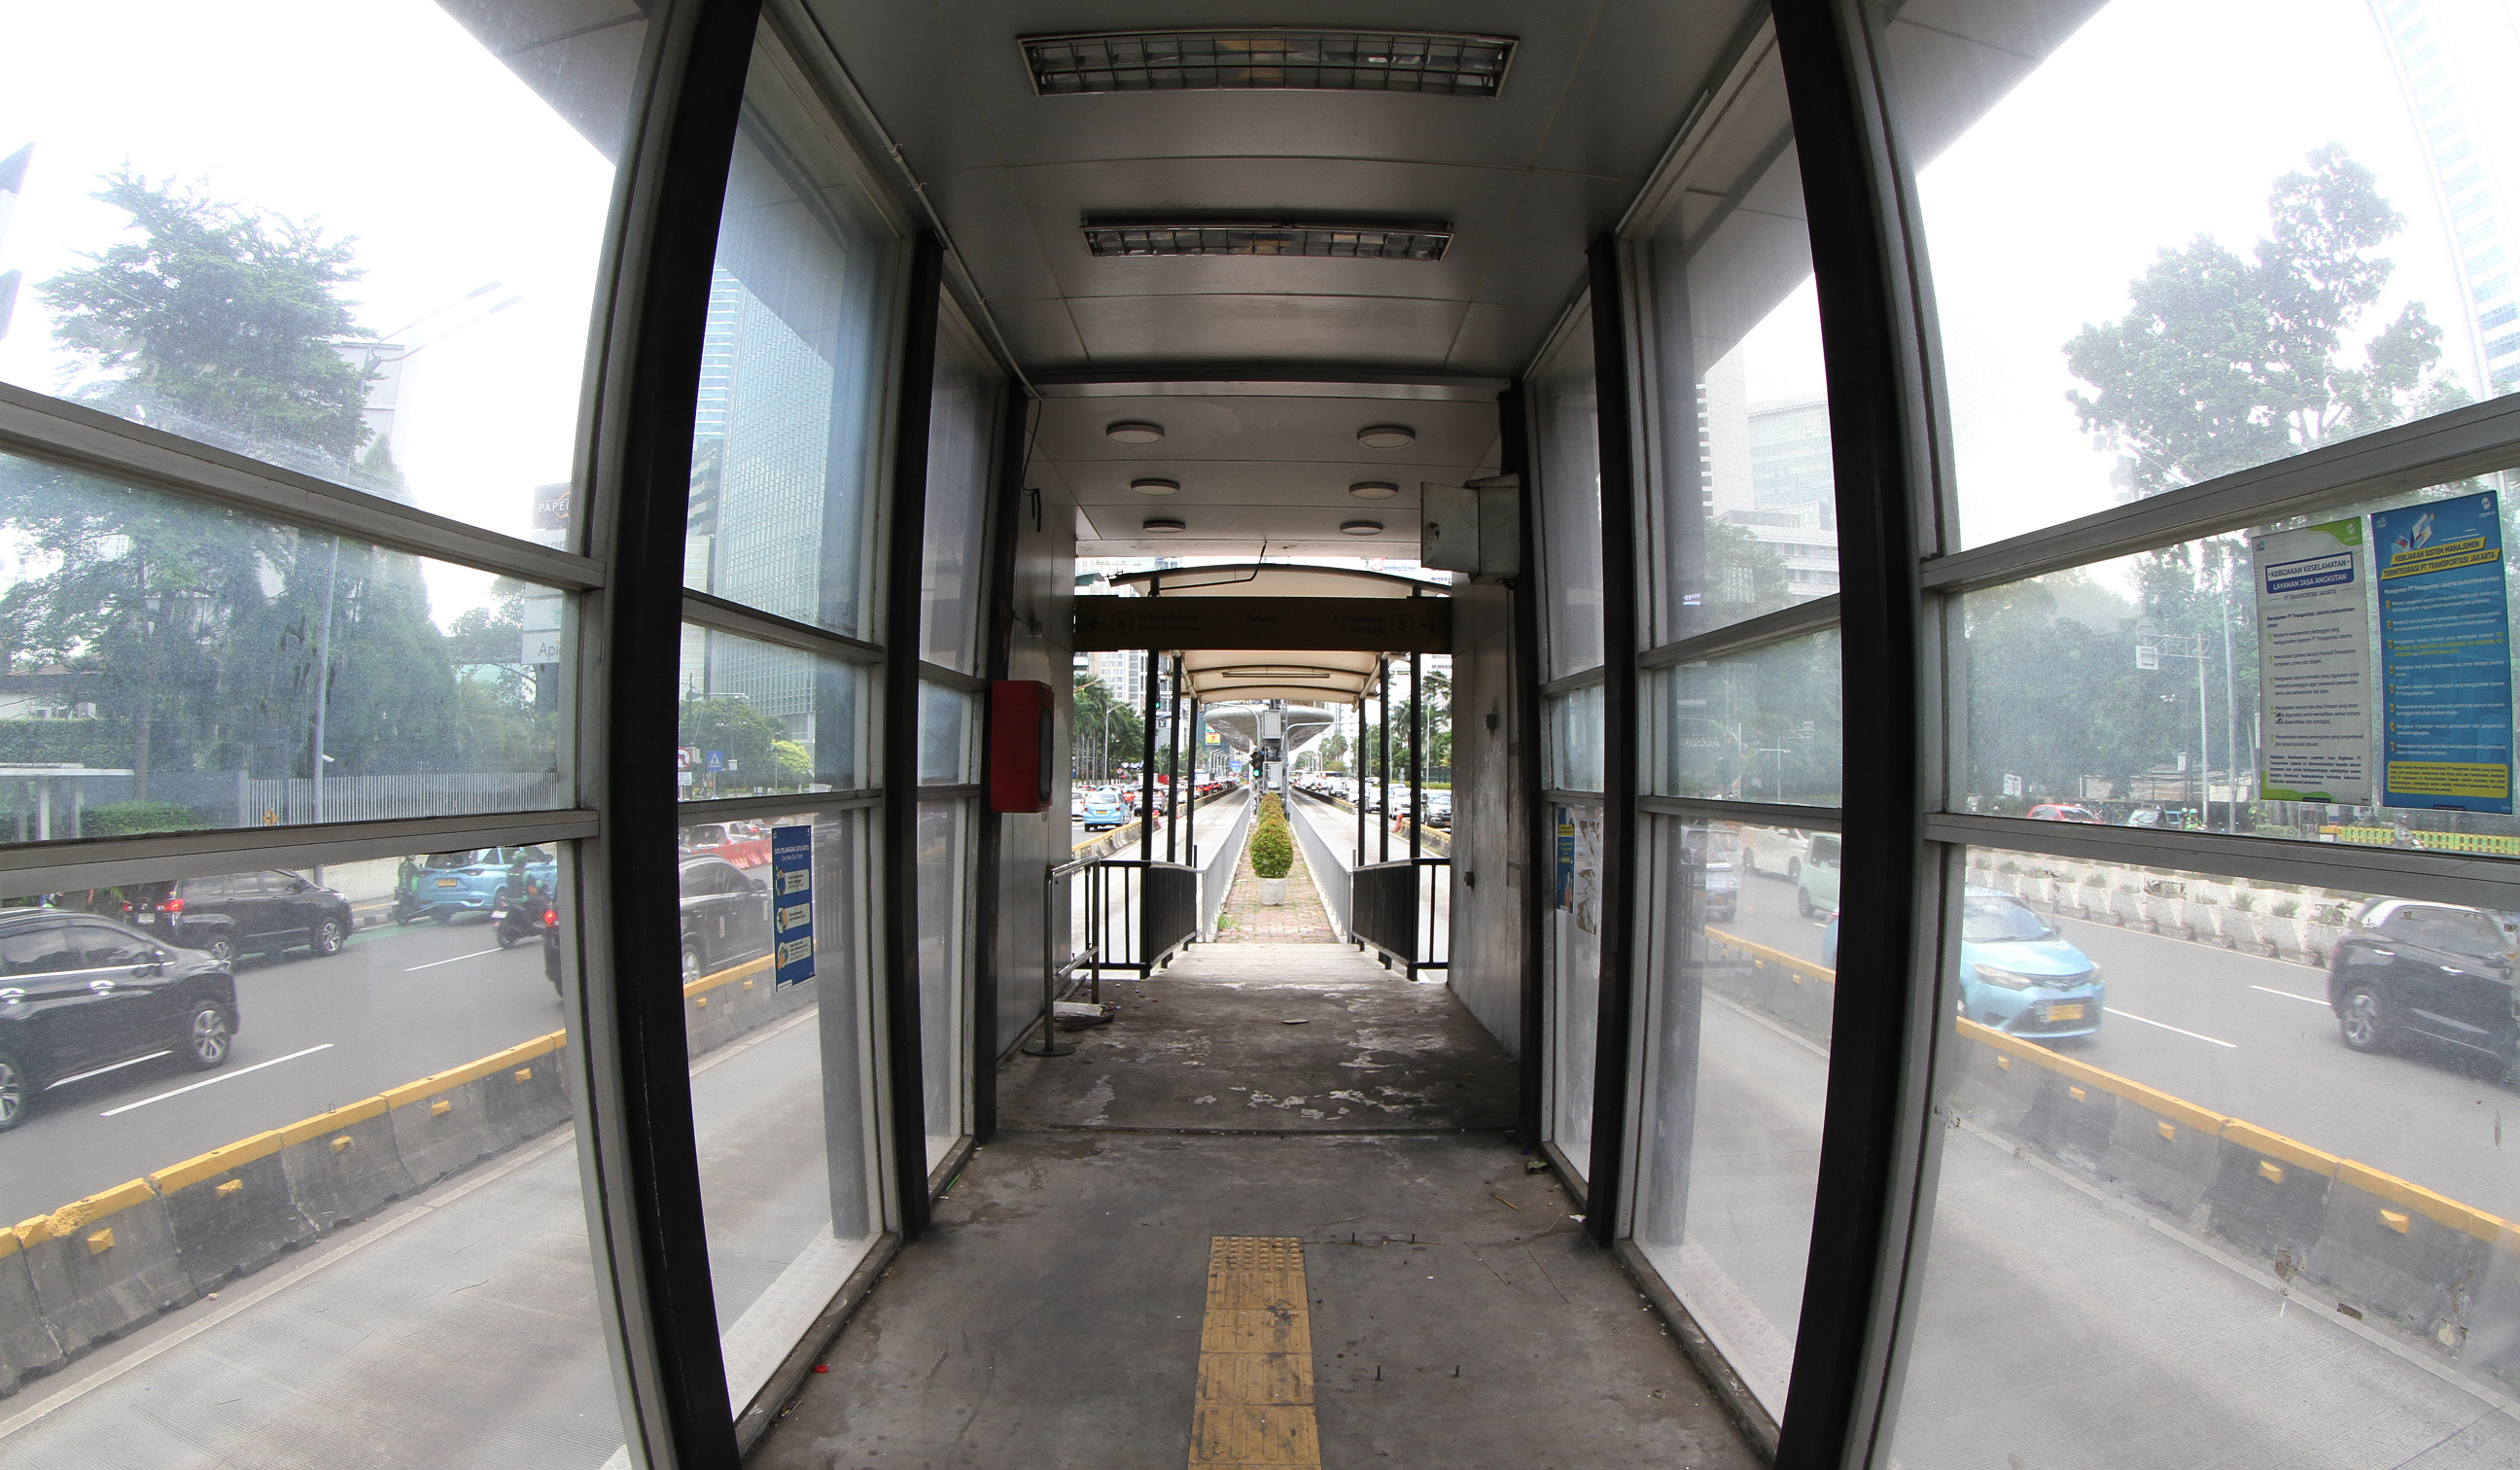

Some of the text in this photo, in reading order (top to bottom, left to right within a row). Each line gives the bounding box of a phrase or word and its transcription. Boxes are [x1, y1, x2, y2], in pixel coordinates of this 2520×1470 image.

[2395, 541, 2480, 563] KEBIJAKAN SISTEM MANAJEMEN
[2271, 559, 2347, 578] KEBIJAKAN KESELAMATAN
[2384, 565, 2420, 578] TERINTEGRASI
[2428, 557, 2468, 569] TRANSPORTASI
[2469, 551, 2496, 562] JAKARTA
[2273, 574, 2347, 590] LAYANAN JASA ANGKUTAN
[1117, 617, 1126, 628] A
[1246, 612, 1278, 622] Keluar
[1397, 619, 1406, 631] B
